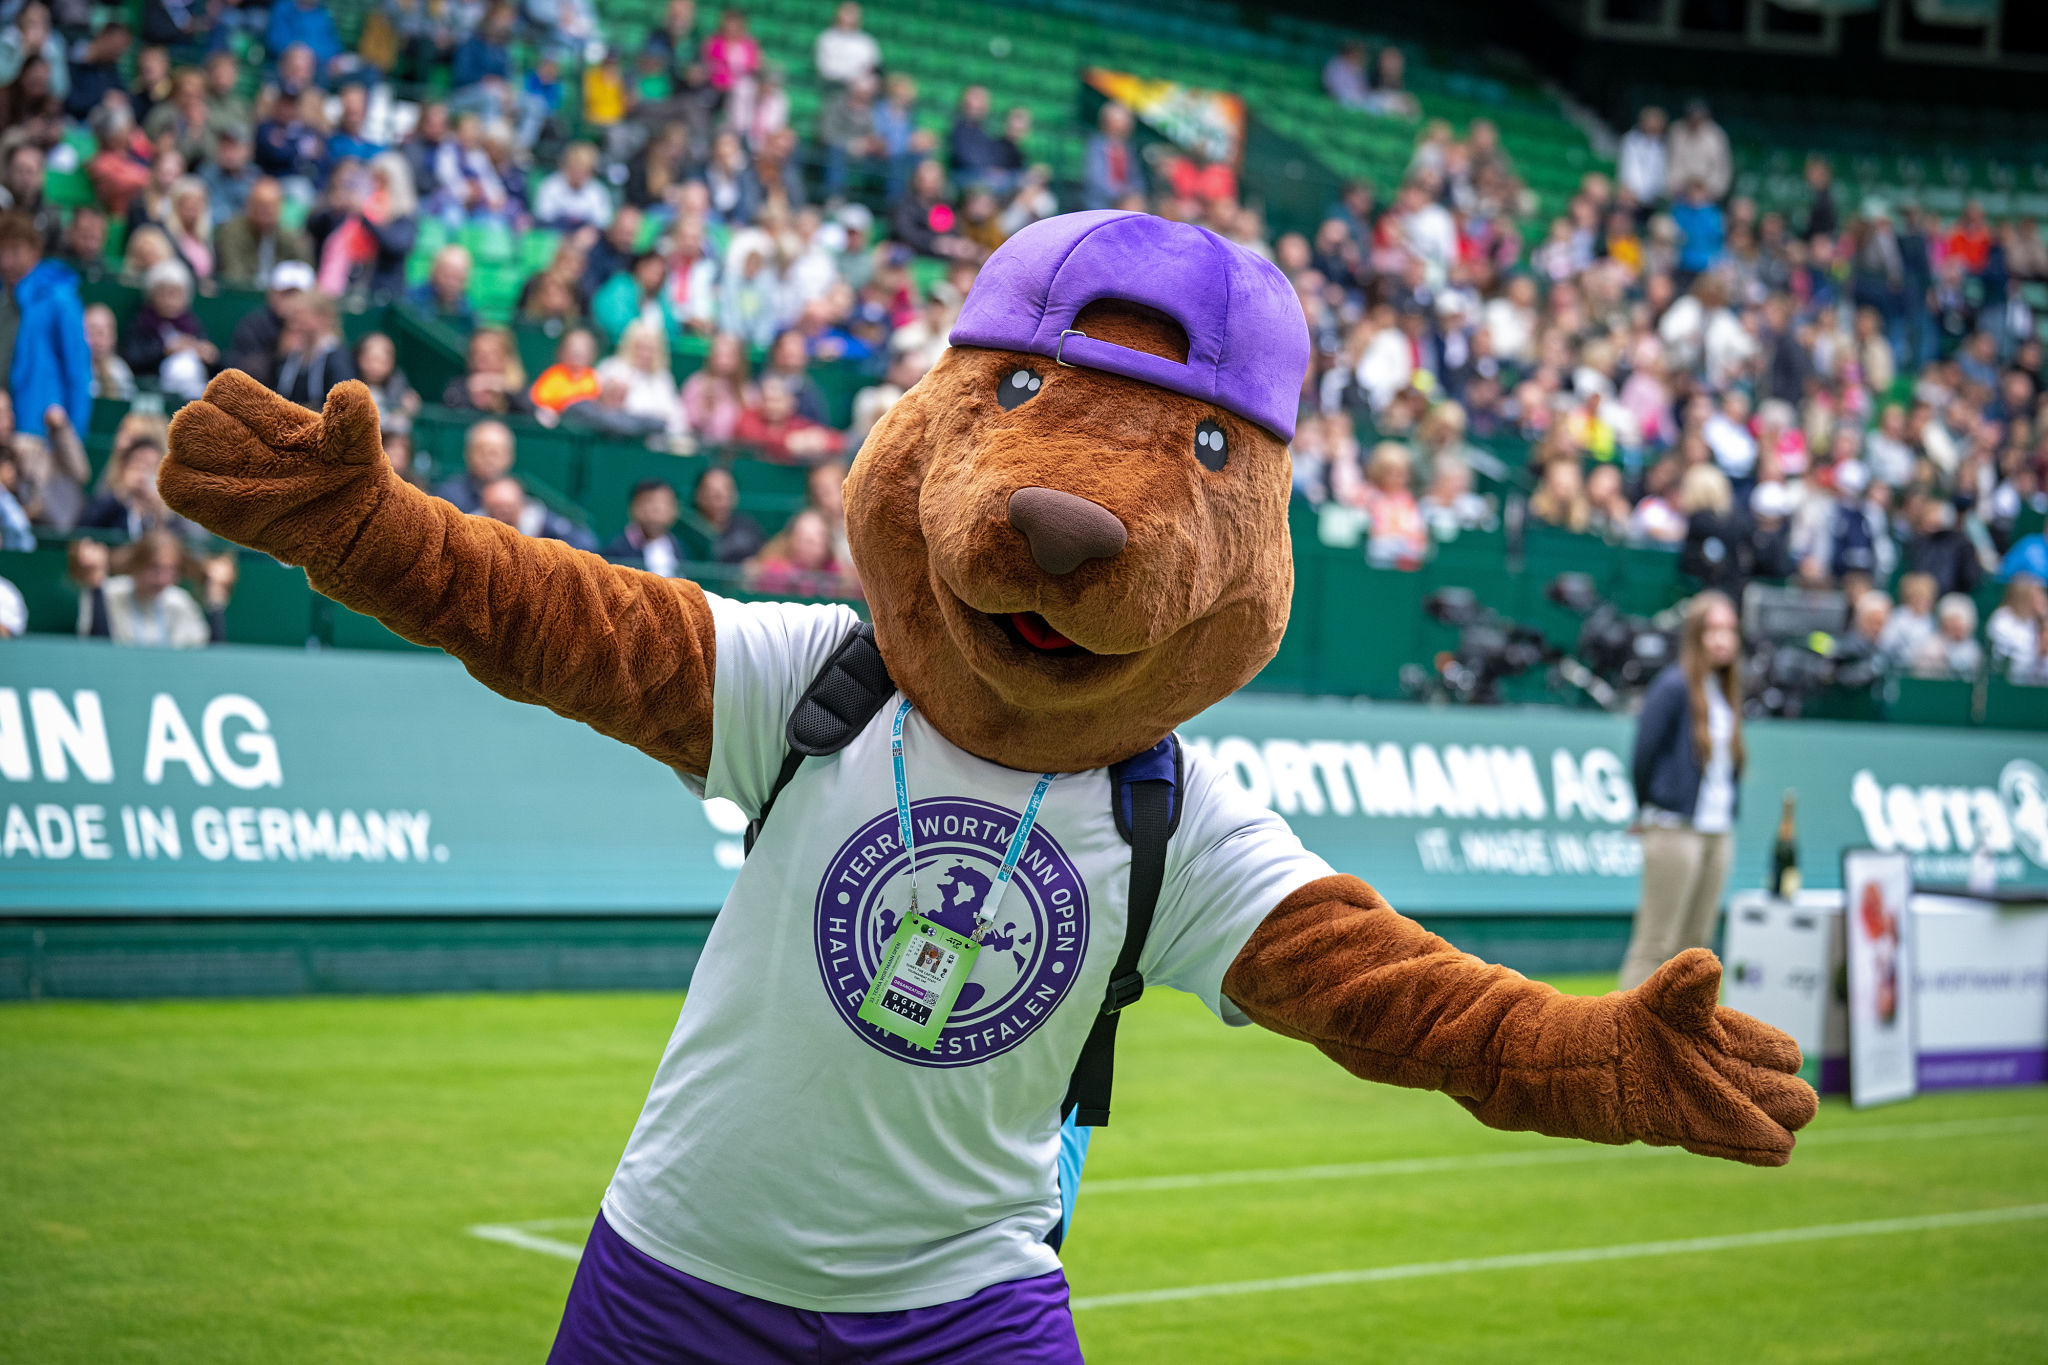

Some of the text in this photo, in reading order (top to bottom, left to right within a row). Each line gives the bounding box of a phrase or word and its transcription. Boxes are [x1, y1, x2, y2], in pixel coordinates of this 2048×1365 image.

[143, 692, 283, 789] AG
[1551, 747, 1637, 824] AG
[1852, 768, 2014, 852] terra
[0, 803, 450, 863] ADE IN GERMANY.
[1051, 888, 1076, 951] OPEN
[829, 917, 866, 1007] HALLE
[893, 978, 924, 996] ORGANIZATION
